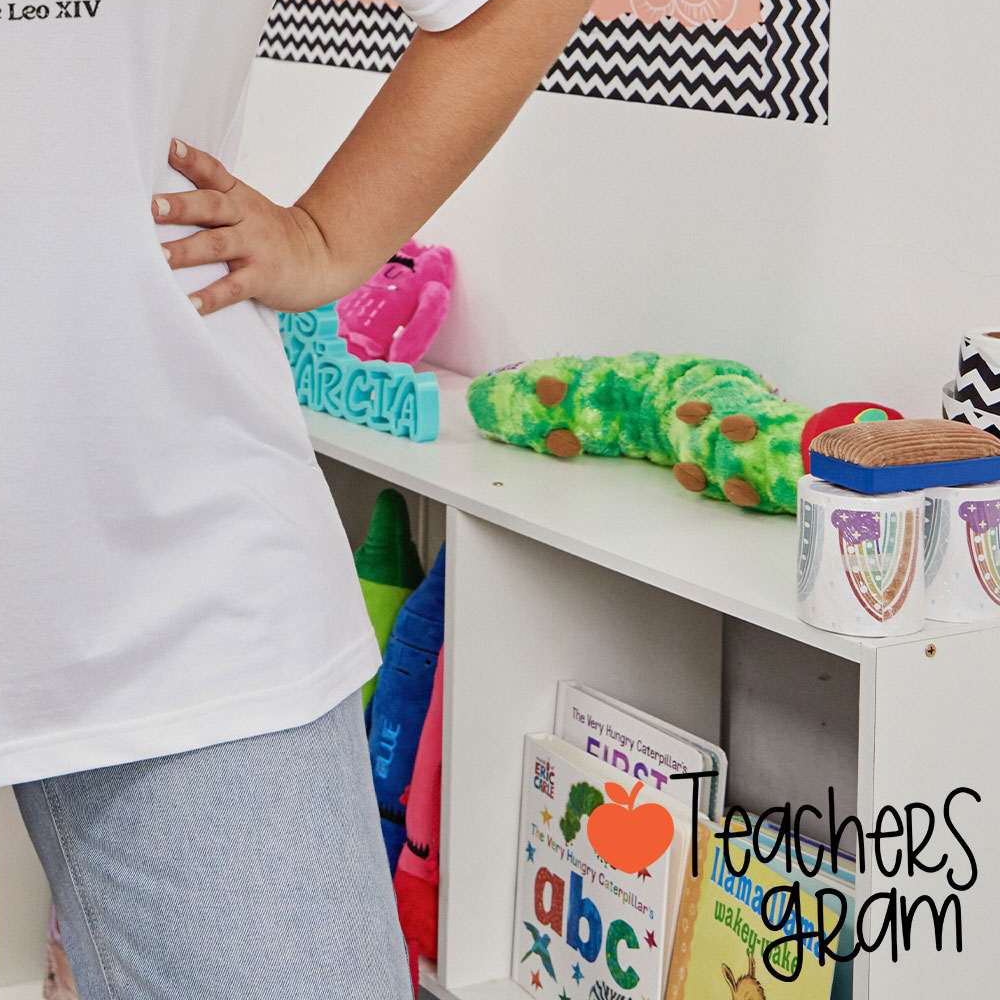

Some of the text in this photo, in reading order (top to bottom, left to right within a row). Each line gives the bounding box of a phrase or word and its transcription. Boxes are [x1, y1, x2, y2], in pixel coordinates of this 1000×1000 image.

[8, 3, 51, 22] Leo
[55, 0, 102, 19] XIV
[286, 345, 418, 436] ARCIA
[375, 718, 401, 779] BLUE
[572, 706, 688, 774] The Very Hungry Caterpillar's
[533, 775, 555, 800] CARLE
[535, 761, 556, 785] ERIC
[531, 823, 655, 921] The Very Hungry Caterpillar's
[534, 867, 640, 990] abc
